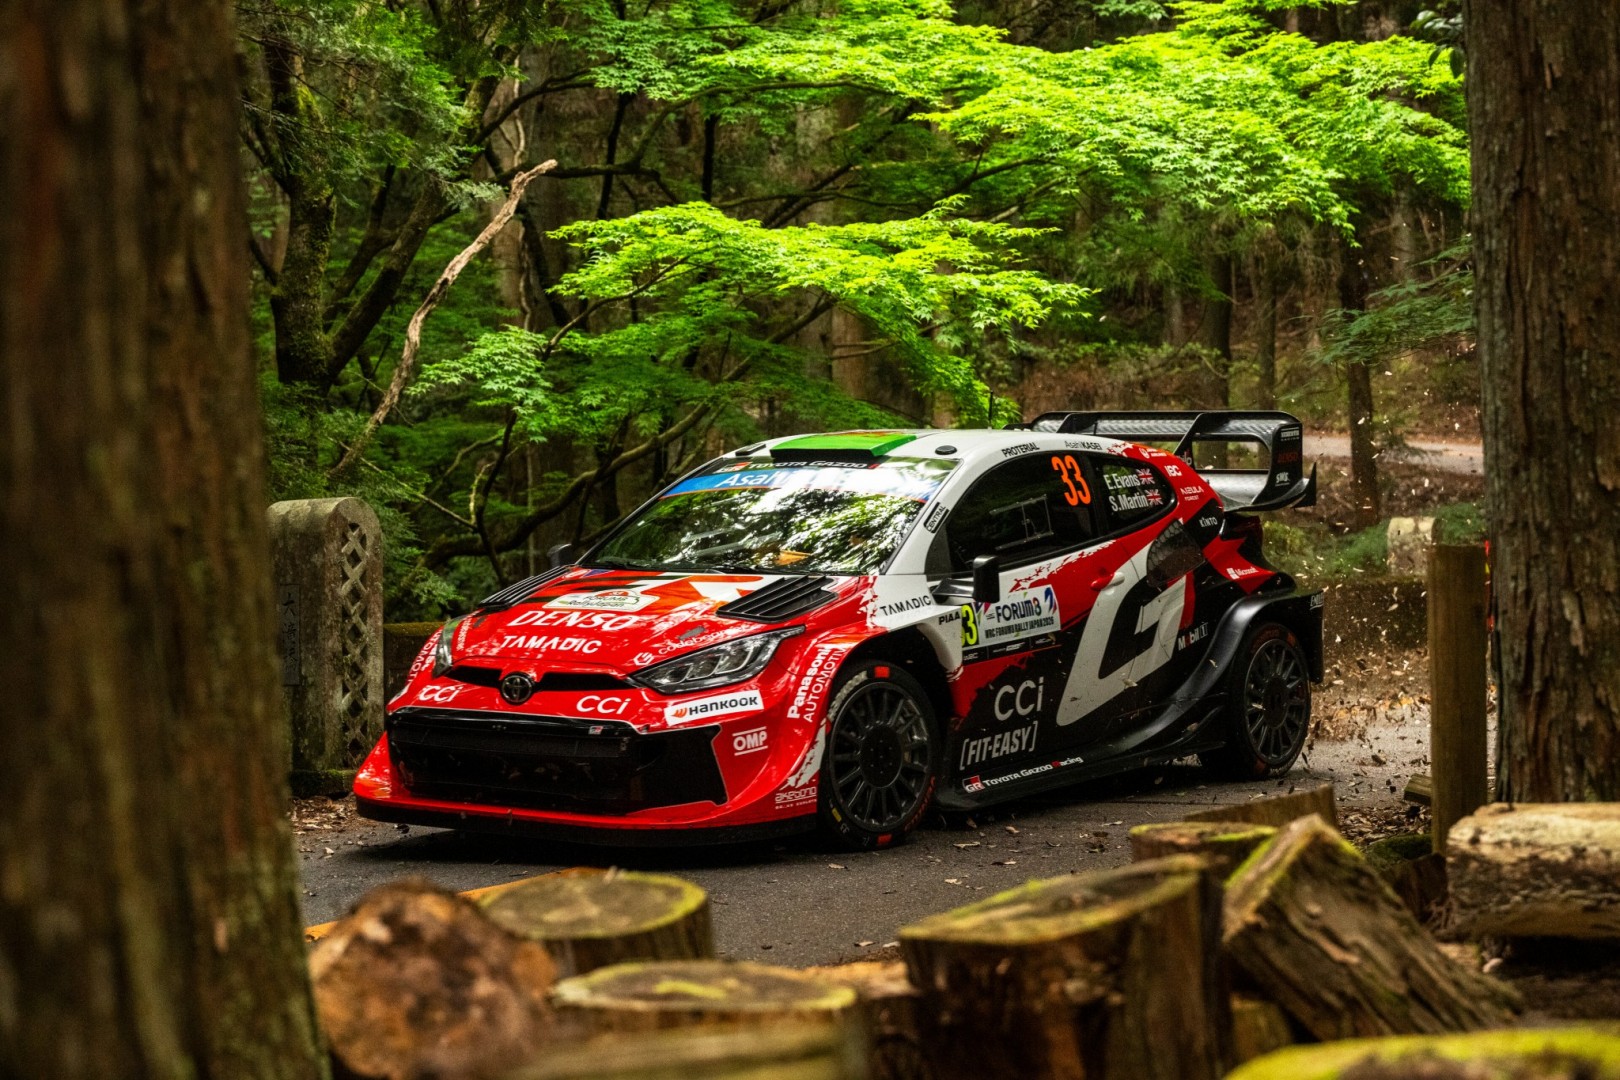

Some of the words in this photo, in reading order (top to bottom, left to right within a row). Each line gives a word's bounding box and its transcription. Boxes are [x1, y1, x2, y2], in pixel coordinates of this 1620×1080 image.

[1001, 441, 1040, 457] PROTERIAL
[809, 461, 867, 469] GAZOO
[1051, 455, 1091, 506] 33
[1103, 473, 1140, 490] E.Evans
[1108, 494, 1148, 512] S.Martin
[879, 595, 931, 616] TAMADIC
[507, 610, 641, 631] DENSO
[938, 611, 960, 625] PIAA
[961, 603, 978, 646] 3
[500, 635, 602, 654] TAMADIC
[576, 695, 632, 714] CCi
[733, 731, 768, 751] OMP
[984, 772, 1021, 787] TOYOTA
[1021, 764, 1053, 777] GAZOO
